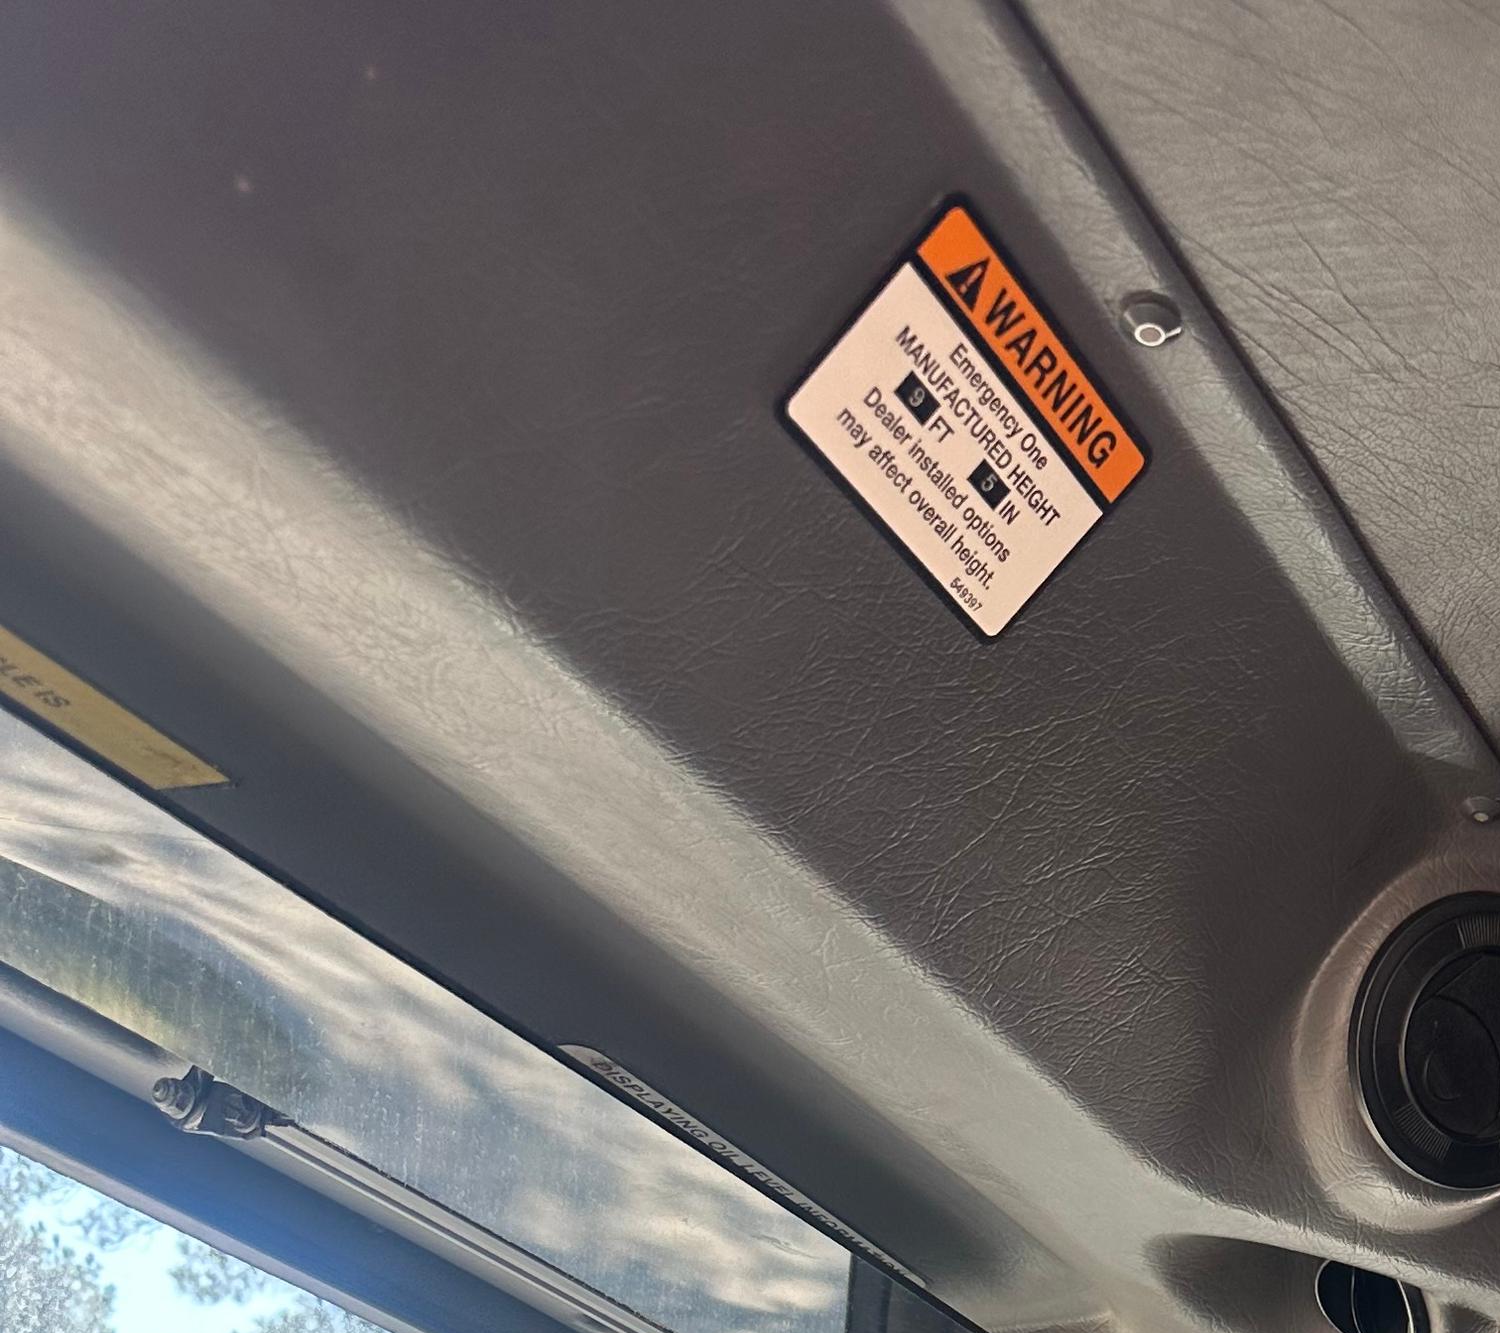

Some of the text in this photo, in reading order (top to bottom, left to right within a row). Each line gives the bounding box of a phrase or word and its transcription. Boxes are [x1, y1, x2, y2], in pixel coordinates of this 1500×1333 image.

[895, 325, 1061, 528] MANUFACTURED HEIGHT
[908, 386, 1019, 526] 9 FT 5 IN
[949, 343, 1049, 471] Emergency One
[984, 289, 1116, 471] WARNING
[836, 407, 993, 592] may affect overall height.
[863, 386, 1011, 564] Dealer installed options
[949, 576, 983, 613] 549397
[592, 1057, 709, 1139] DISPLAYING
[708, 1141, 748, 1167] OIL
